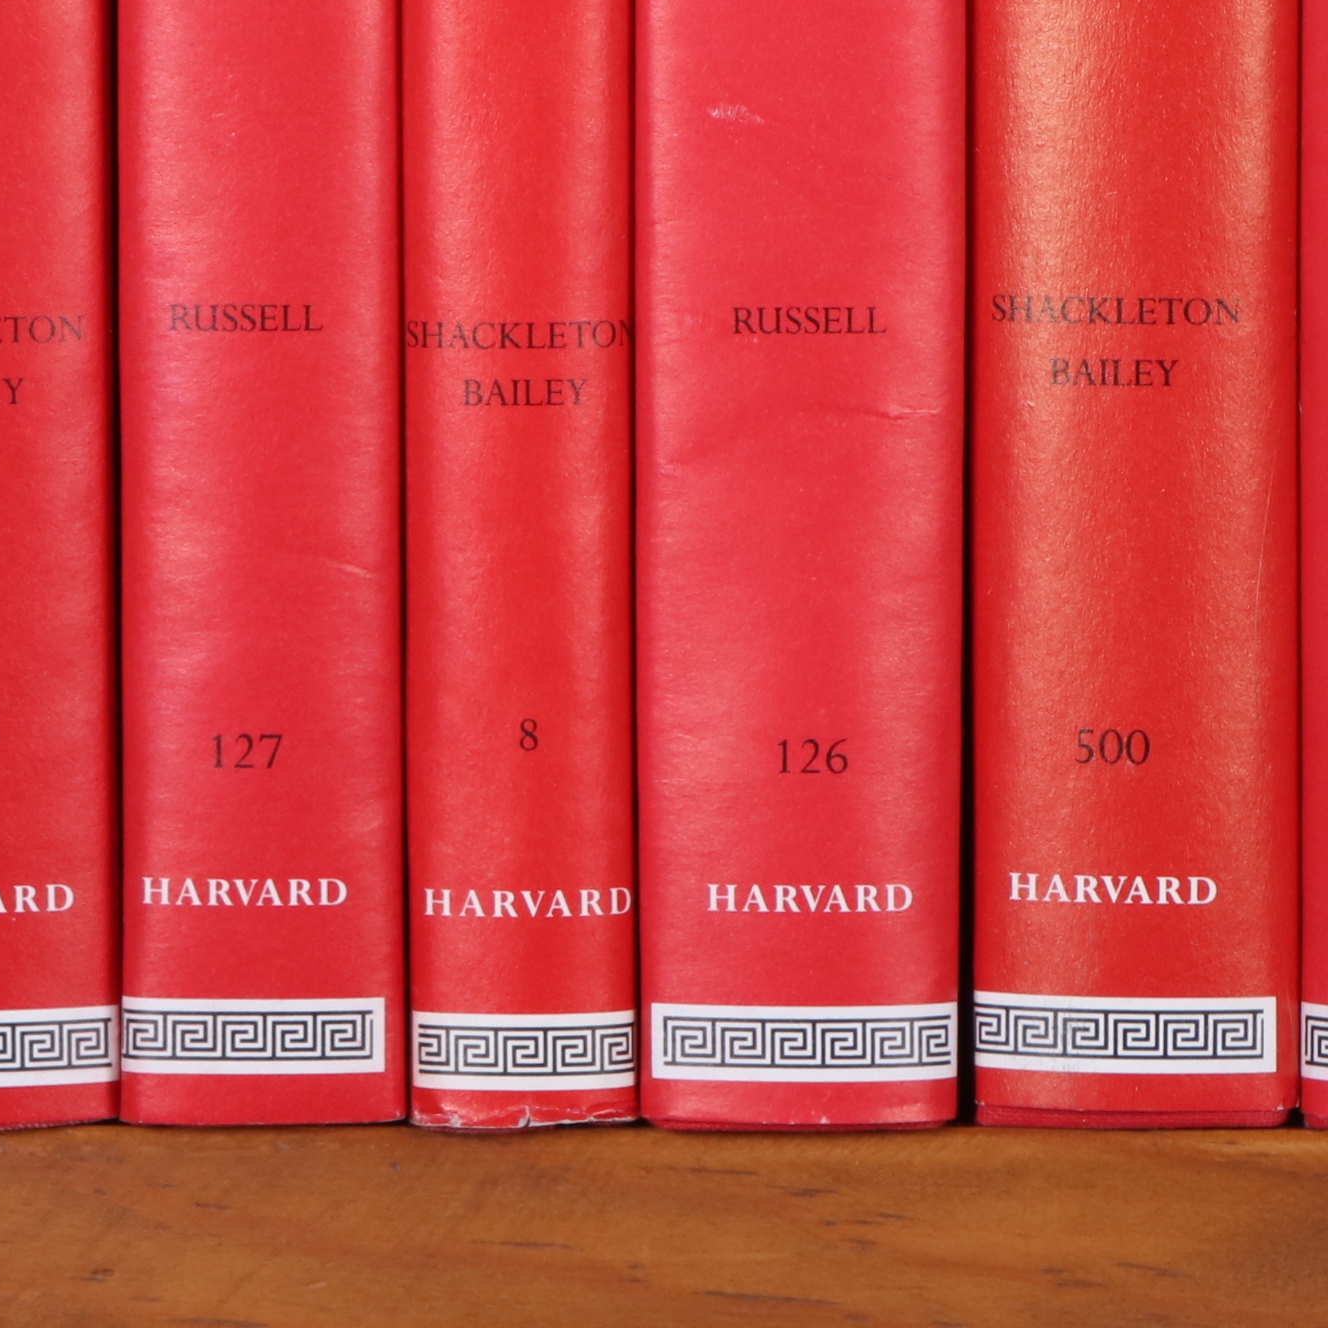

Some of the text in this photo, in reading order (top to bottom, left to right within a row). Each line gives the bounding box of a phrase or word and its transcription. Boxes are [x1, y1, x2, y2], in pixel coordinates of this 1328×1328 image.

[170, 302, 324, 333] RUSSELL
[731, 305, 887, 336] RUSSELL
[991, 294, 1241, 326] SHACKLETON
[1049, 357, 1180, 388] BAILEY
[462, 377, 589, 408] BAILEY
[518, 717, 540, 752] 8
[1074, 727, 1151, 766] 500
[210, 732, 283, 770] 127
[776, 738, 849, 775] 126
[141, 876, 348, 908] HARVARD
[423, 885, 632, 919] HARVARD
[706, 882, 914, 914] HARVARD
[1008, 872, 1218, 906] HARVARD
